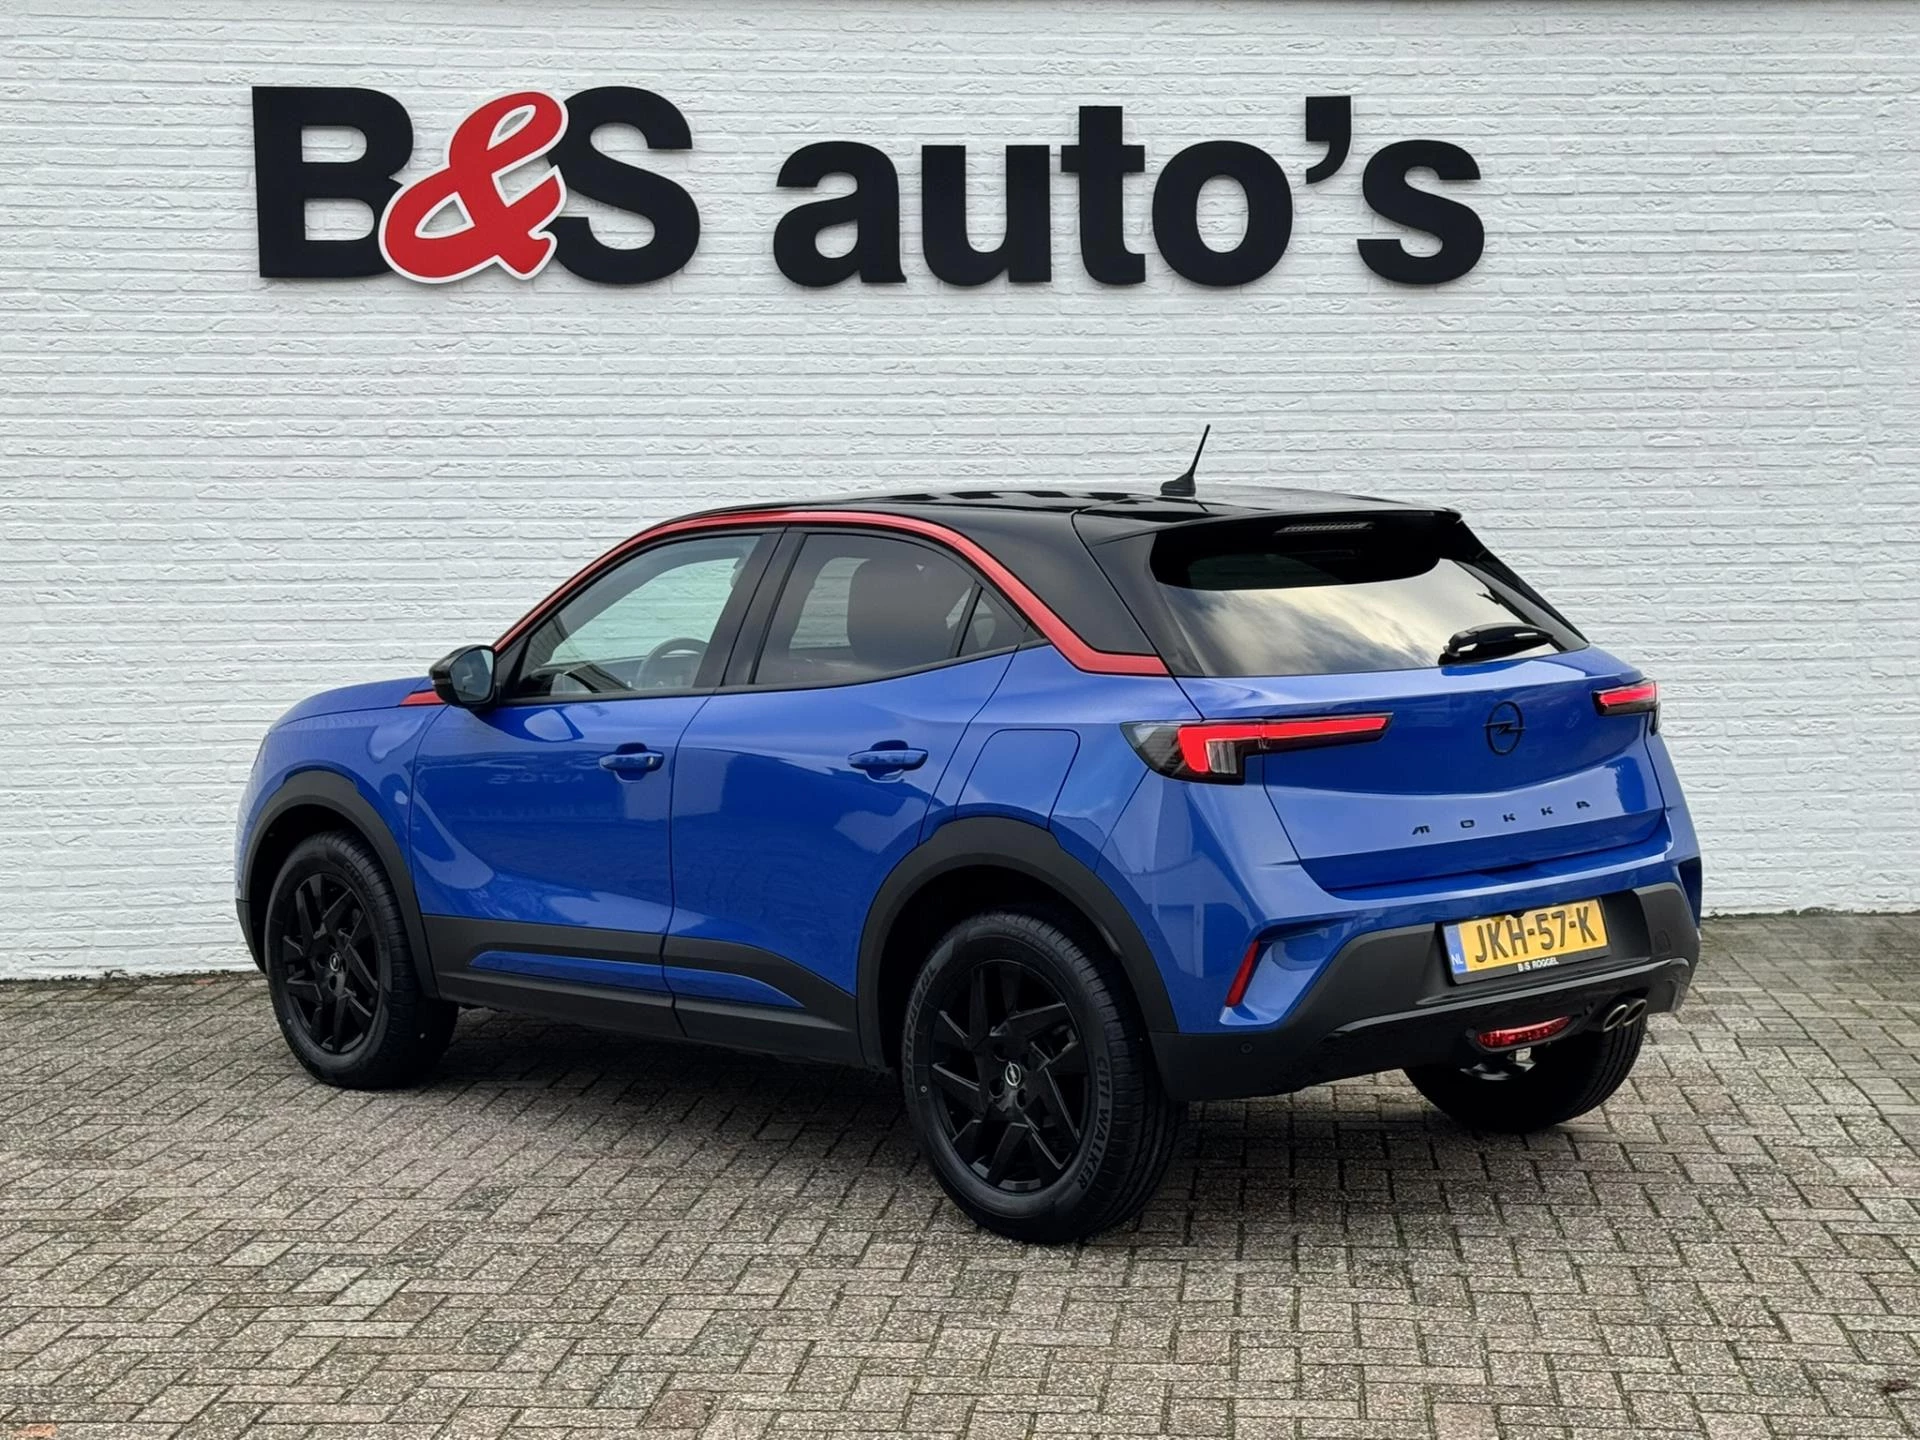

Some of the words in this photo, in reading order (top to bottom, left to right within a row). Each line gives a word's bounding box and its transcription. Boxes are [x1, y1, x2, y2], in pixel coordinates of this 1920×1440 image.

[252, 86, 700, 284] B&S
[773, 95, 1485, 287] auto's
[1412, 800, 1590, 835] MOKKA
[1450, 953, 1464, 966] NL
[1475, 906, 1597, 963] JKH-57-K
[1096, 1055, 1111, 1098] CITI
[1079, 1107, 1110, 1191] WALKER
